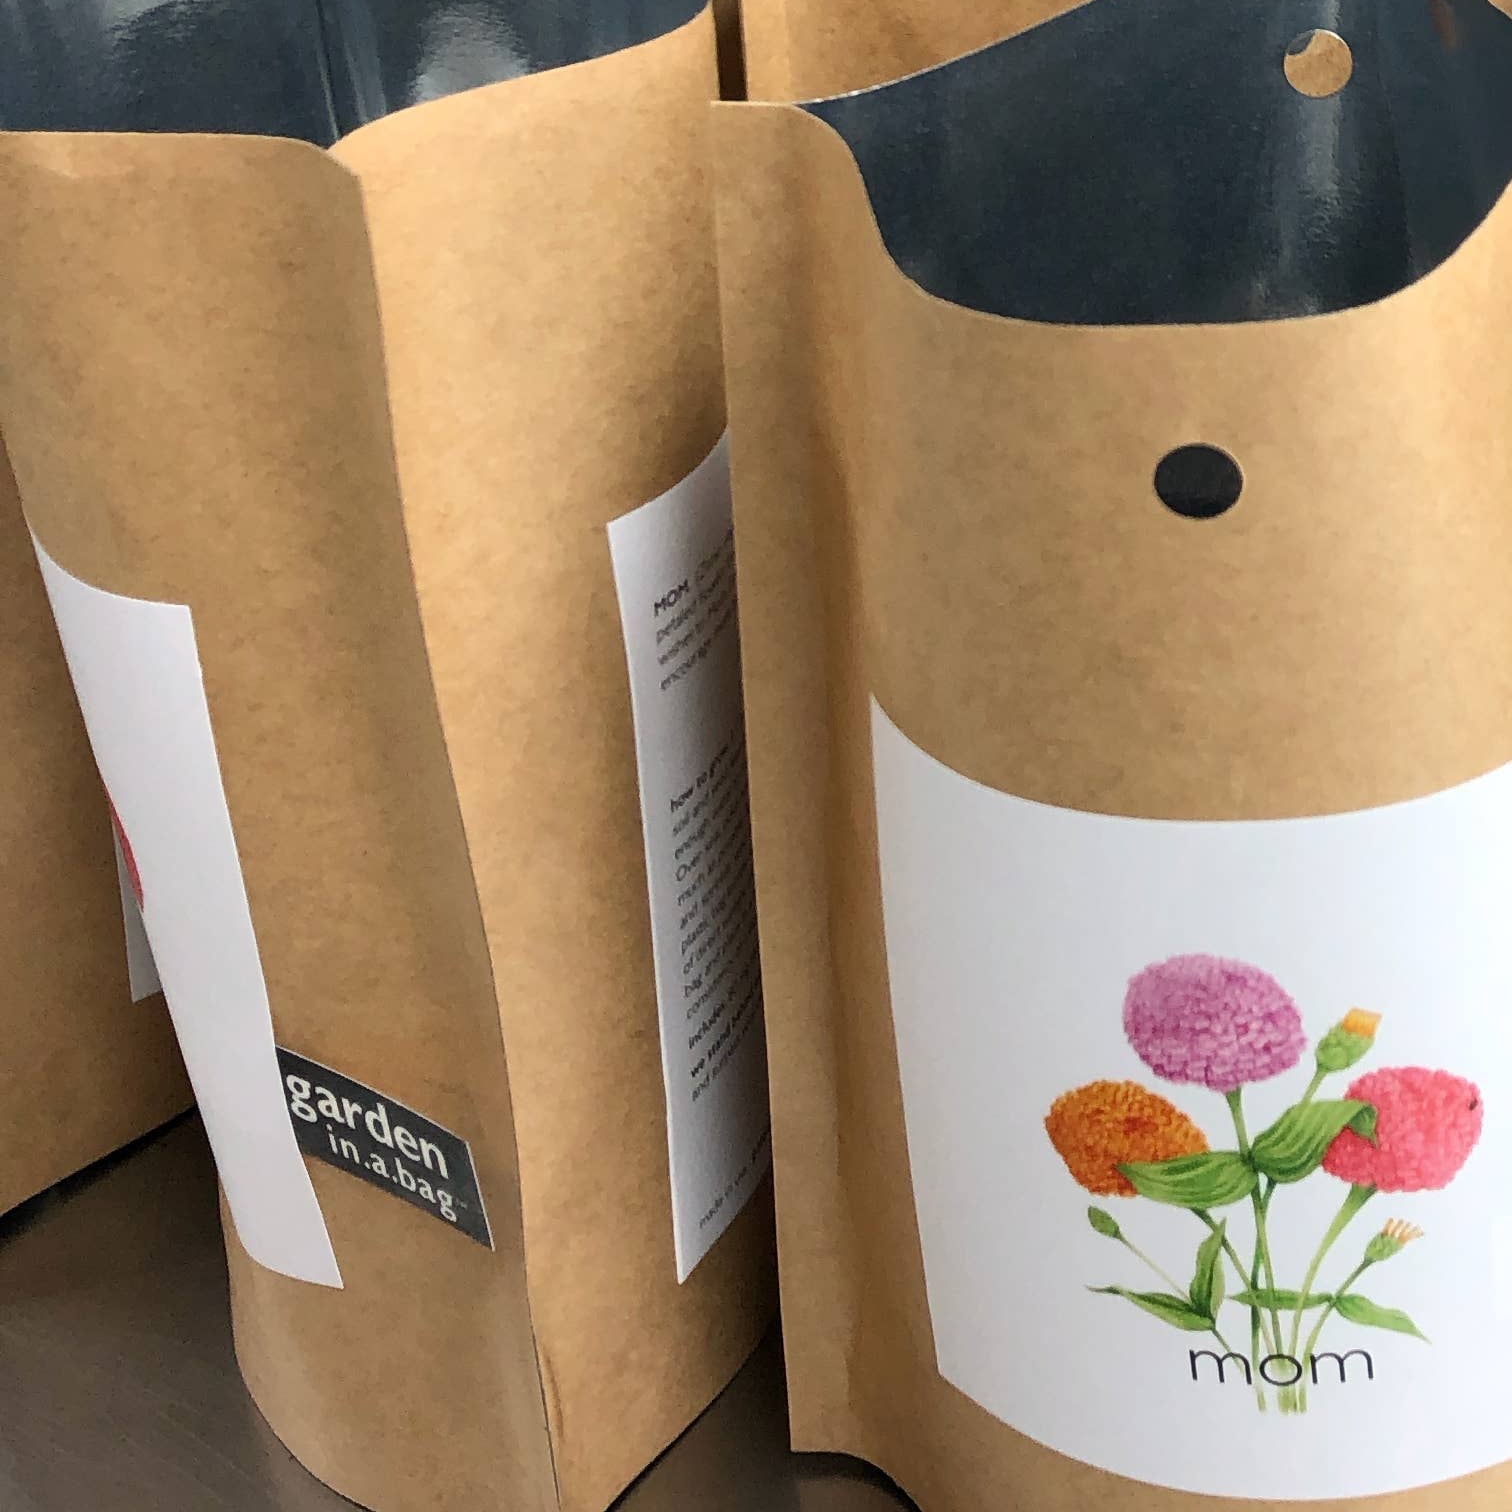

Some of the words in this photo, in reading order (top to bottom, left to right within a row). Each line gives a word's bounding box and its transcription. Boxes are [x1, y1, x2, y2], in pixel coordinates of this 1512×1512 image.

[286, 1074, 449, 1179] garden
[326, 1123, 457, 1223] in.a.bag
[1189, 1349, 1374, 1386] mom
